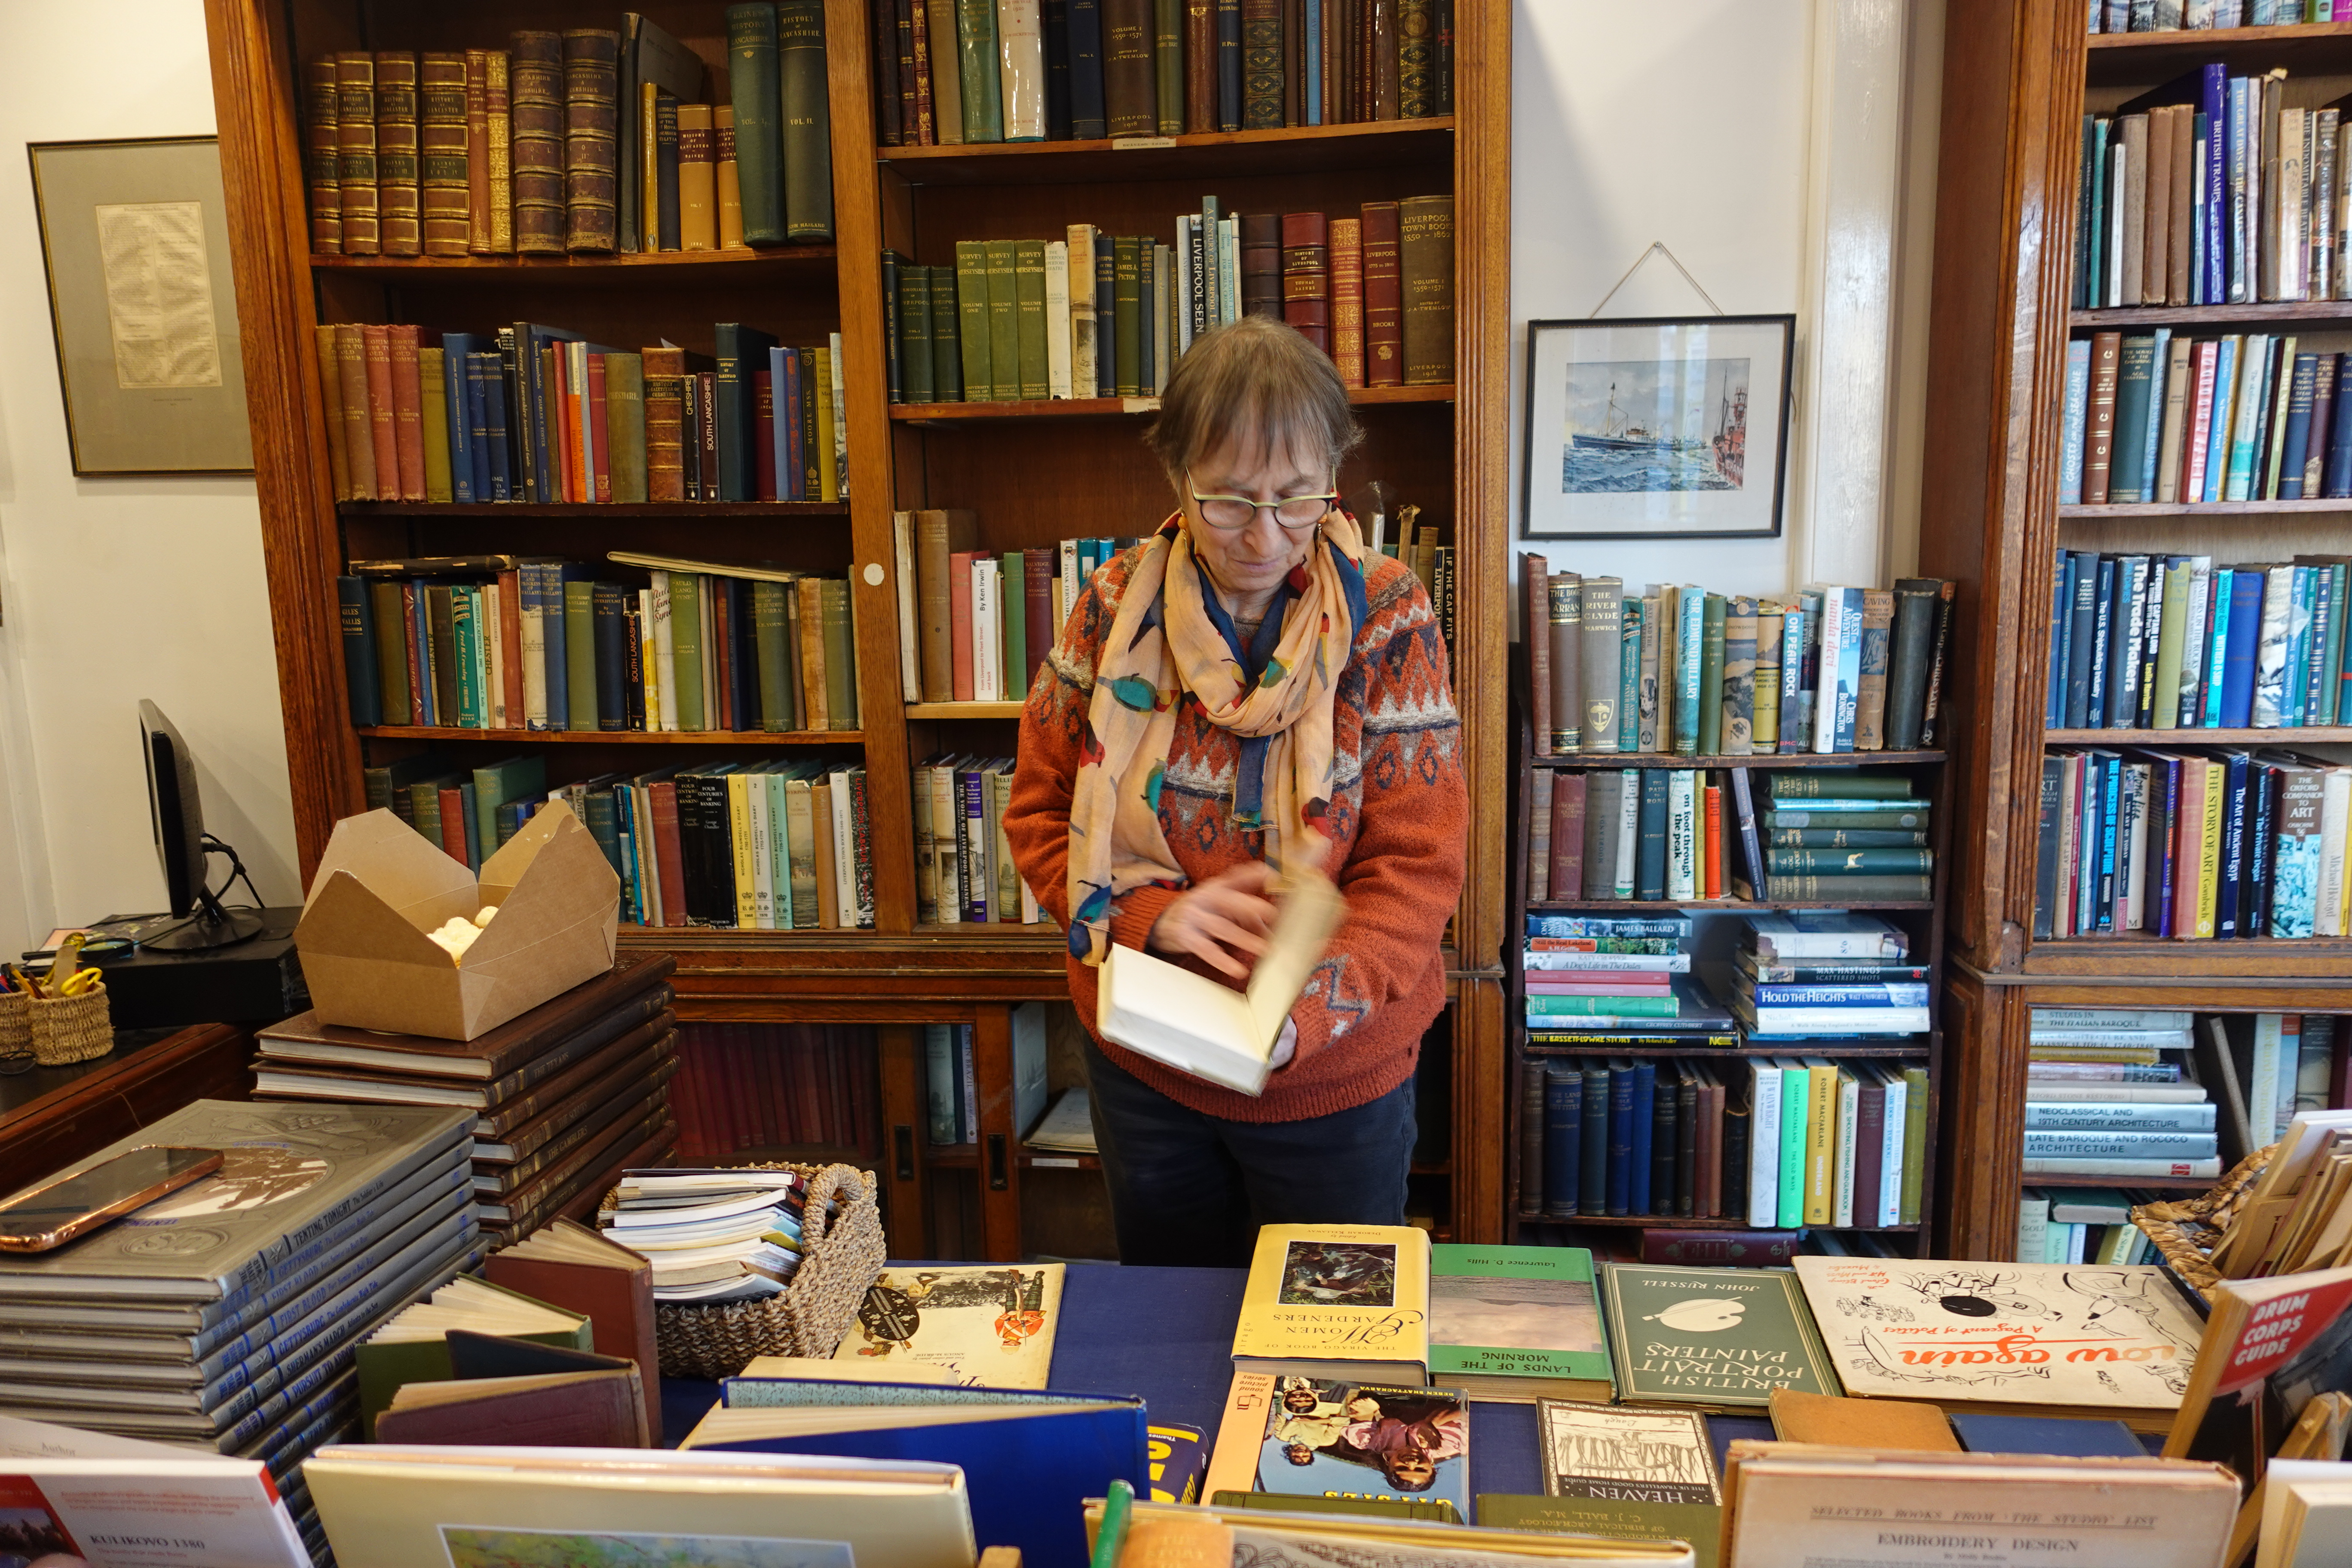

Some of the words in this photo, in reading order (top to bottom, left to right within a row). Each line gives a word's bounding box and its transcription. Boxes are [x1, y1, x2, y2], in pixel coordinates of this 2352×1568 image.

[783, 15, 814, 24] HISTORY
[780, 30, 821, 39] LANCASHIRE.
[1111, 114, 1152, 122] LIVERPOOL
[2213, 120, 2222, 160] BRITISH
[2213, 162, 2221, 203] TRAMPS
[1401, 223, 1426, 233] TOWN
[1428, 223, 1454, 231] BOOKS
[1404, 214, 1451, 224] LIVERPOOL
[1403, 233, 1421, 242] 1550
[1209, 254, 1214, 264] OF
[1193, 238, 1204, 301] LIVERPOOL
[1412, 284, 1444, 292] 1550-1571
[1194, 303, 1204, 333] SEEN
[685, 376, 693, 415] CHESHIRE
[704, 377, 712, 423] LANCASHIRE
[2070, 370, 2081, 414] SEA-LINE
[2066, 442, 2077, 482] GHOSTS
[1446, 557, 1452, 567] IF
[2133, 564, 2148, 591] The
[980, 603, 986, 611] By
[1552, 603, 1580, 613] ARRAN
[1690, 596, 1700, 613] SIR
[1862, 597, 1890, 606] CAVING
[1584, 612, 1618, 620] CLYDE
[1827, 598, 1838, 637] nanda
[2129, 593, 2146, 637] Trade
[1788, 617, 1798, 634] ON
[1689, 618, 1700, 658] EDMUND
[484, 635, 492, 675] CHESTER
[1786, 637, 1798, 667] PEAK
[1825, 640, 1838, 668] devi
[2125, 637, 2142, 692] Makers
[1686, 659, 1698, 700] HILLARY
[1785, 668, 1796, 697] ROCK
[1837, 692, 1848, 733] BONINGTON
[1846, 701, 1857, 724] CHRIS
[2208, 768, 2219, 793] THE
[855, 778, 864, 825] LIVERPOOL
[1684, 794, 1690, 807] on
[1683, 811, 1691, 830] foot
[2206, 796, 2218, 835] STORY
[2290, 807, 2315, 818] ART
[961, 823, 966, 832] OF
[858, 827, 867, 863] LABOUR
[1674, 830, 1682, 859] peak
[2205, 835, 2215, 851] OF
[1682, 832, 1690, 878] through
[2203, 854, 2214, 875] ART
[2201, 879, 2210, 919] Gombrich
[1615, 924, 1638, 933] JAMES
[1640, 925, 1675, 933] BALLARD
[1762, 991, 1789, 1003] HOLD
[1791, 992, 1806, 1002] THE
[1807, 991, 1846, 1003] HEIGHTS
[2038, 1118, 2059, 1127] 19TH
[2061, 1118, 2105, 1127] CENTURY
[2107, 1120, 2180, 1128] ARCHITECTURE
[2028, 1134, 2055, 1143] LATE
[2058, 1135, 2112, 1144] BAROQUE
[2115, 1135, 2138, 1143] AND
[2141, 1136, 2188, 1144] ROCOCO
[2028, 1145, 2125, 1153] ARCHITECTURE
[294, 1219, 324, 1246] TENTING
[323, 1200, 352, 1225] TONIGHT
[1642, 1280, 1710, 1290] RUSSELL
[1718, 1284, 1759, 1292] JOHN
[2252, 1293, 2311, 1323] DRUM
[1274, 1310, 1423, 1333] GARDENERS
[1960, 1323, 2023, 1334] Pageant
[2243, 1315, 2303, 1345] CORPS
[1239, 1322, 1253, 1352] virago
[1286, 1325, 1399, 1344] WOMEN
[1482, 1353, 1549, 1362] MORNING
[1645, 1342, 1788, 1363] PAINTERS
[1898, 1335, 2050, 1368] again
[2235, 1337, 2291, 1366] GUIDE
[1462, 1360, 1488, 1370] THE
[1498, 1363, 1514, 1371] OF
[1523, 1364, 1571, 1373] LANDS
[1635, 1359, 1803, 1379] PORTRAIT
[1360, 1386, 1424, 1395] BHATTACHARYA
[1663, 1376, 1790, 1390] BRITISH
[40, 1442, 76, 1457] Author
[1589, 1486, 1684, 1503] HEAVEN
[90, 1535, 168, 1547] KULIKOVO
[172, 1539, 205, 1549] 1380
[1877, 1532, 1998, 1549] EMBROIDERY
[2012, 1537, 2079, 1552] DESIGN
